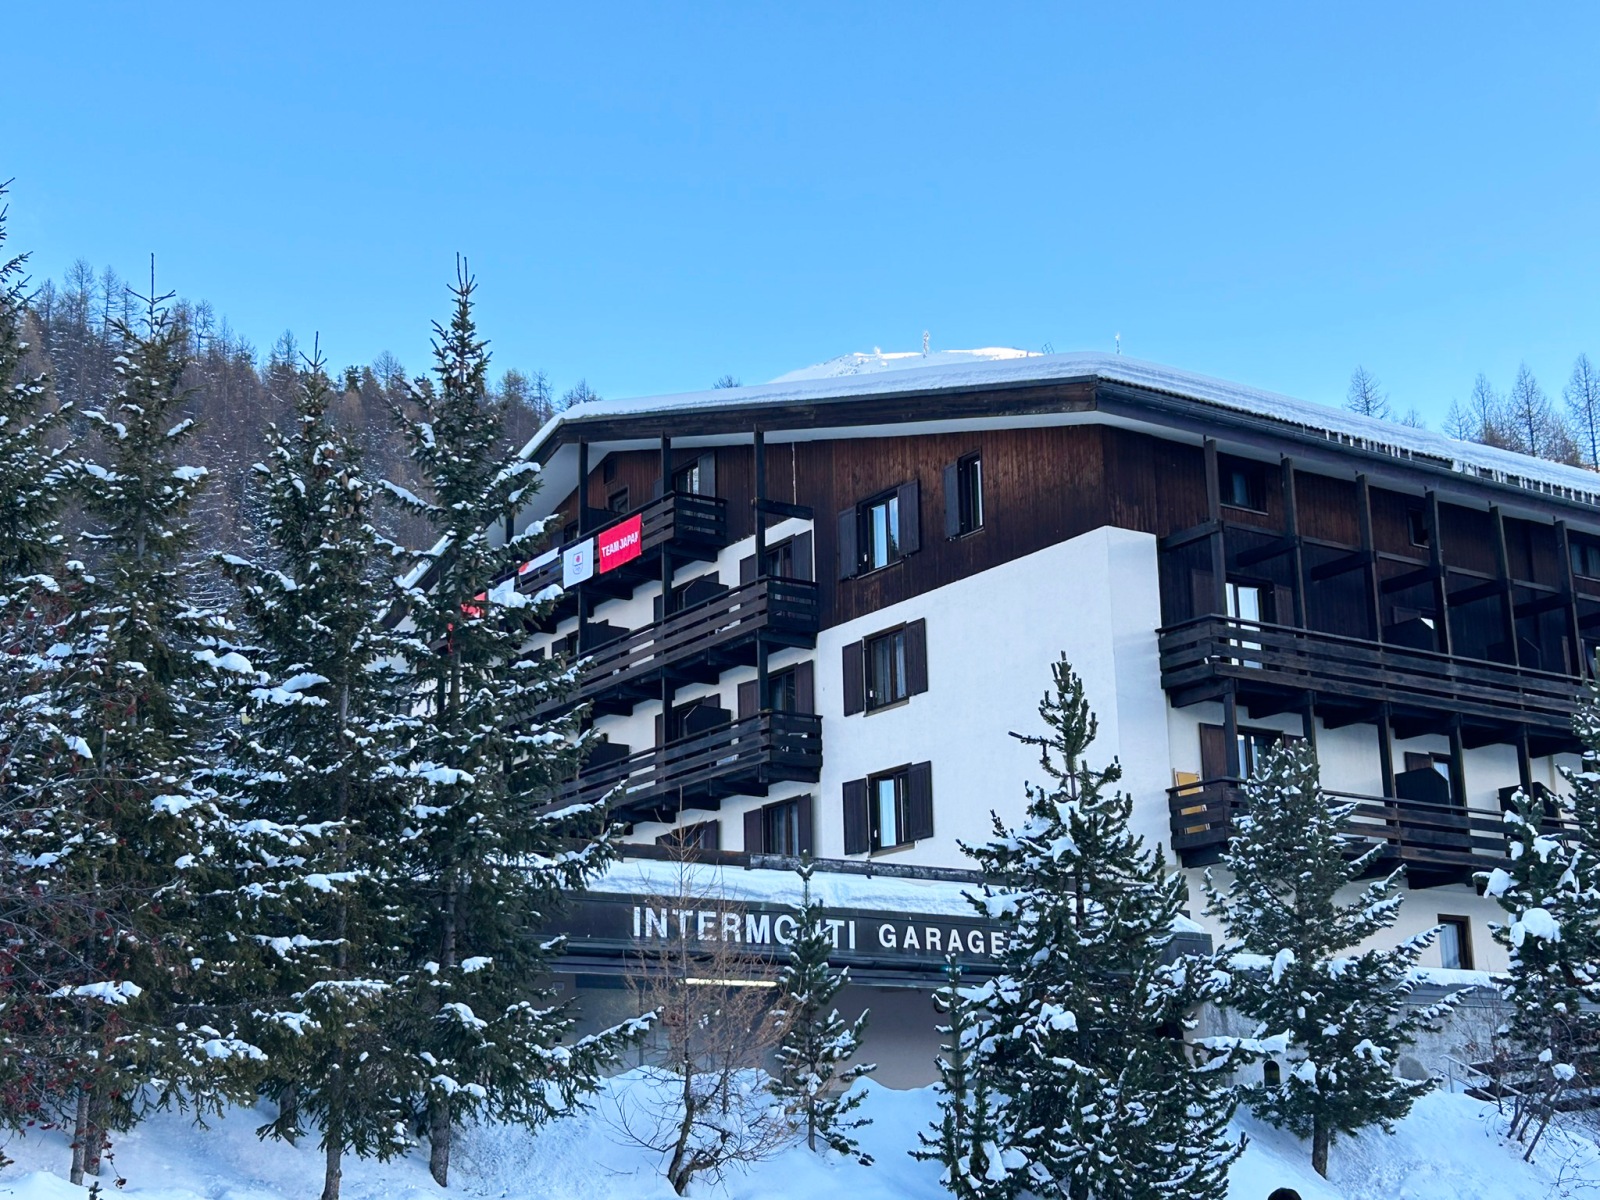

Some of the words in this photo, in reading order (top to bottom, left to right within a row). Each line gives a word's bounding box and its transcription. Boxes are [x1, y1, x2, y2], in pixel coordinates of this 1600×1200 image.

[601, 540, 620, 557] TEAM
[619, 531, 640, 550] JAPAN
[878, 923, 1005, 955] GARAGE
